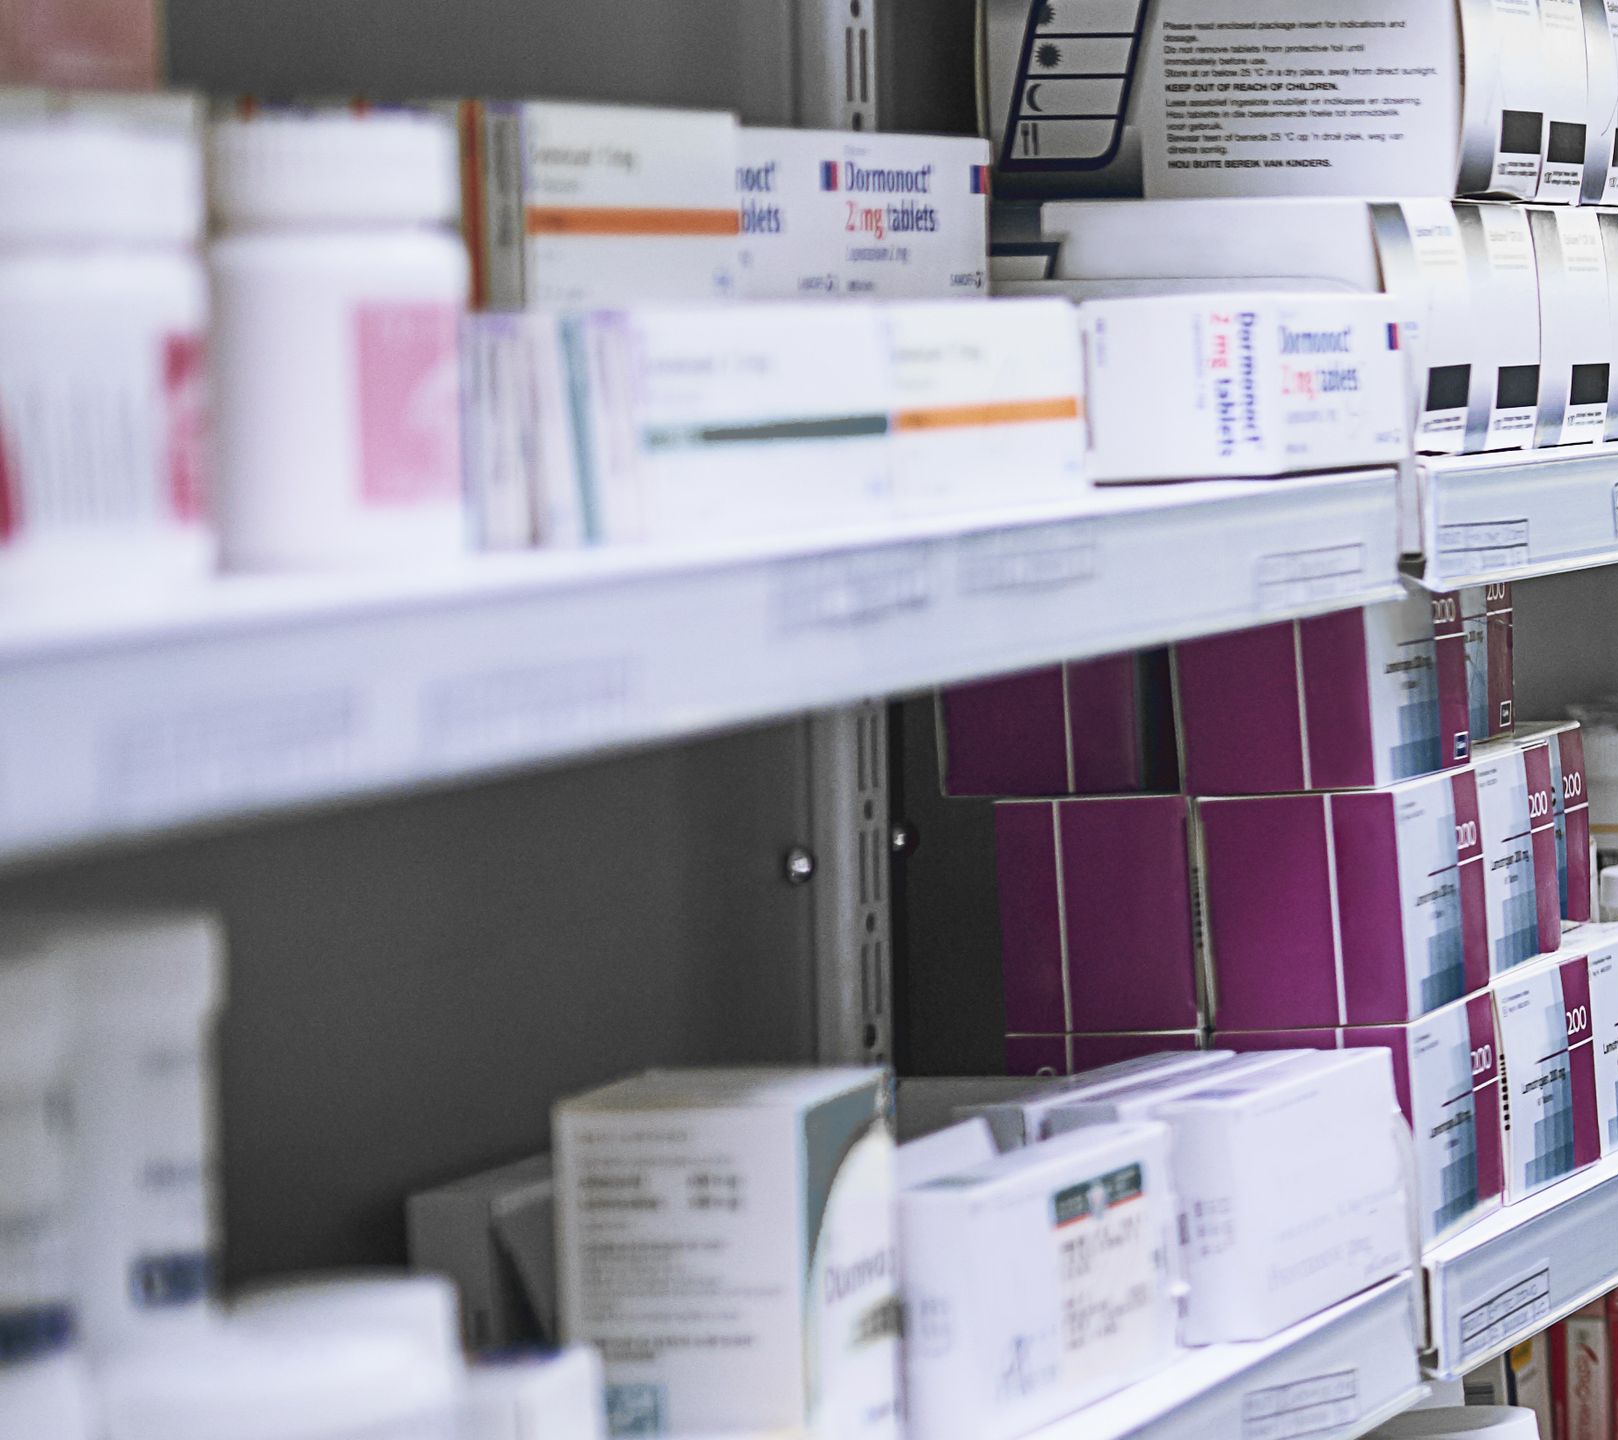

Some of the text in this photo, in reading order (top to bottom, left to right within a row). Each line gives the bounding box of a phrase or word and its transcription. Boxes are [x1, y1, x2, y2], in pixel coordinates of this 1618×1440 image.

[1165, 83, 1190, 92] KEEP
[1195, 83, 1215, 91] OUT
[1217, 83, 1230, 91] OF
[1233, 83, 1267, 91] REACH
[1270, 83, 1283, 91] OF
[741, 199, 781, 234] blets
[846, 199, 936, 240] 2 mg tablets
[1563, 772, 1582, 800] 200
[1528, 790, 1548, 818] 200
[1455, 821, 1477, 849] 200
[1566, 1006, 1587, 1035] 200
[1470, 1044, 1492, 1075] 200
